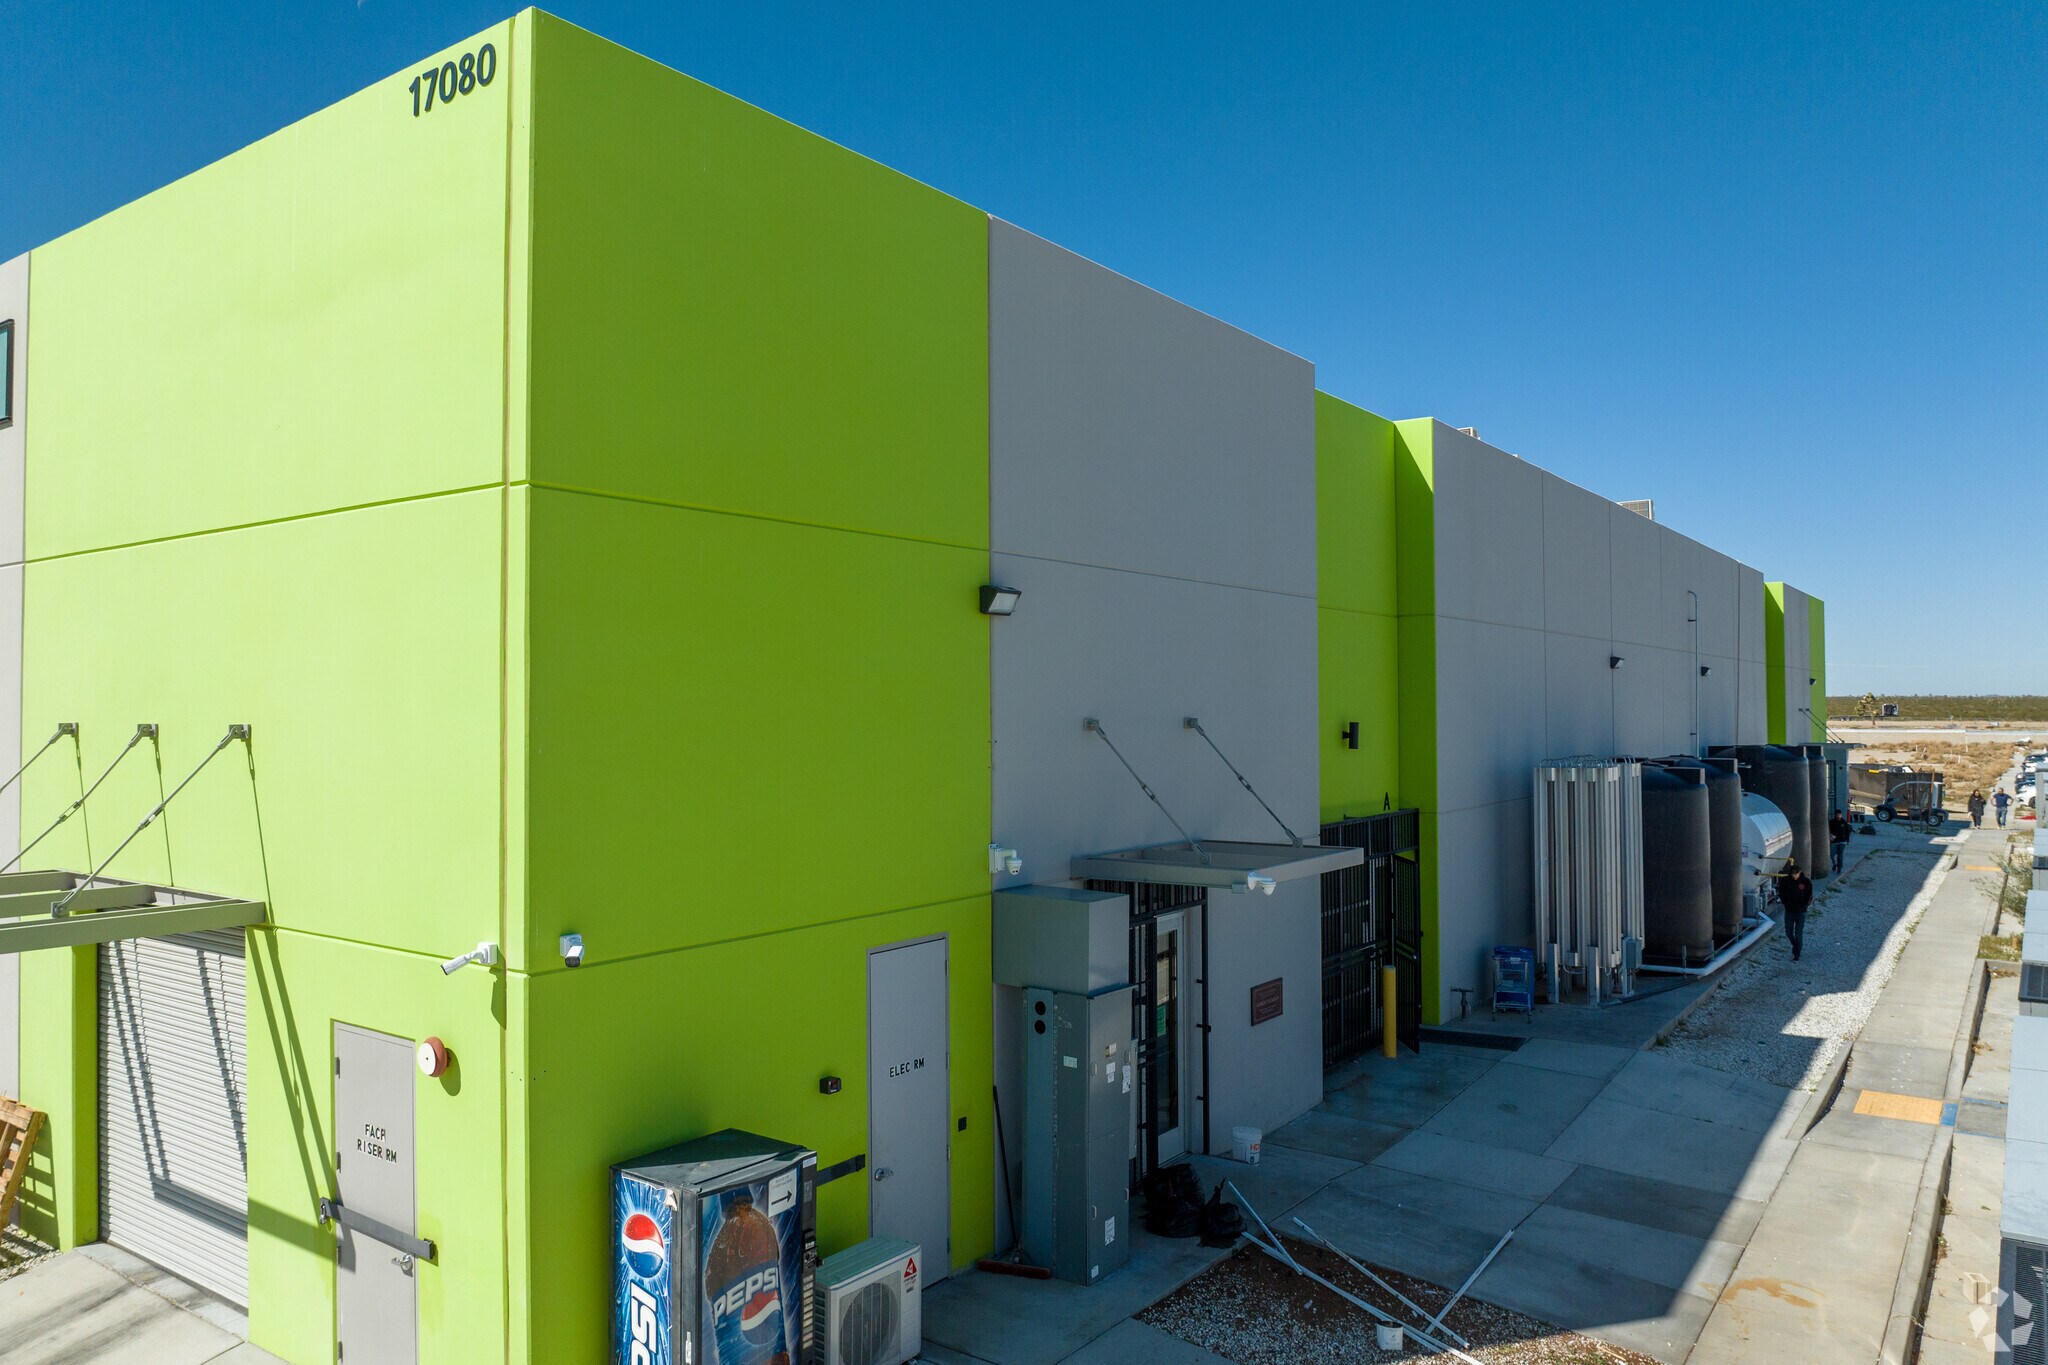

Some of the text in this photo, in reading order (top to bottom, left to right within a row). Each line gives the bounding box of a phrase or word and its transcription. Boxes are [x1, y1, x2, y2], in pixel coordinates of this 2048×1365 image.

[408, 43, 497, 118] 17080
[1383, 791, 1391, 811] A
[889, 1057, 925, 1078] ELEC RM
[357, 1138, 397, 1164] RISER RM
[713, 1267, 779, 1327] PEPSI
